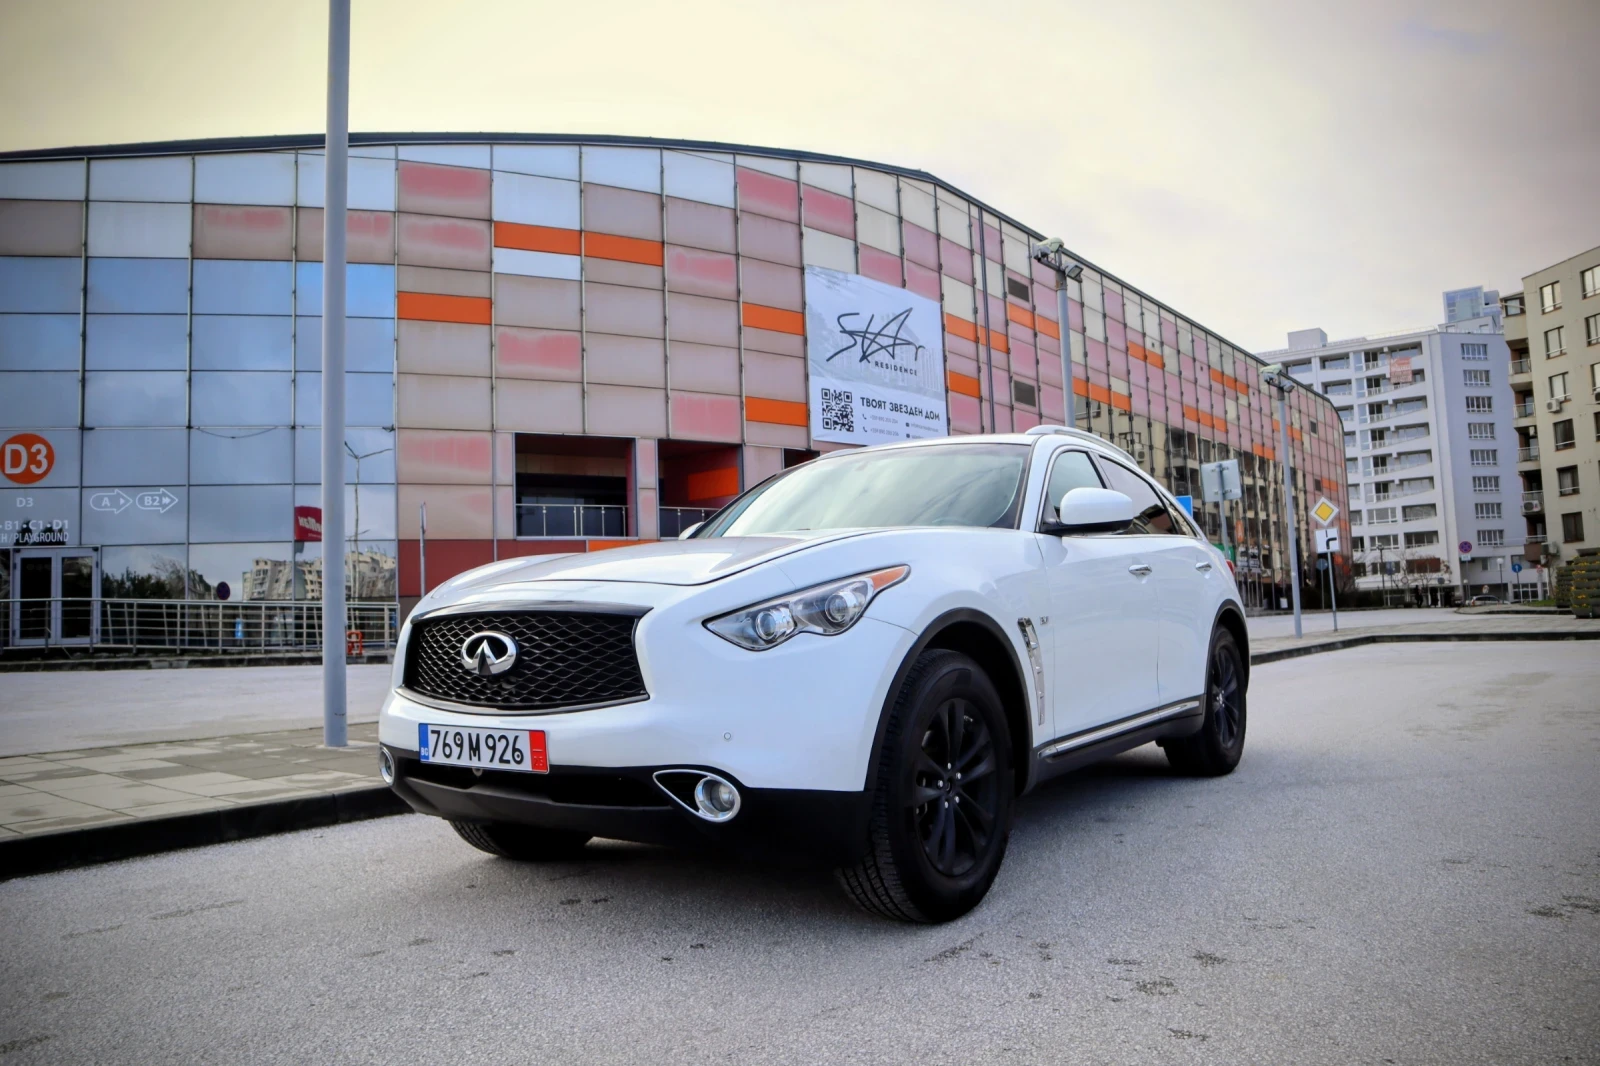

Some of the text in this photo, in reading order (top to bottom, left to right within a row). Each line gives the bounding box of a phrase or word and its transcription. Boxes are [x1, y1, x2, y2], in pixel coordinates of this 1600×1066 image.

[875, 361, 917, 376] RESIDENCE
[860, 397, 940, 421] ТВОЯТ ЗВЕЗДЕН ДОМ
[4, 443, 48, 475] D3
[16, 497, 34, 508] D3
[101, 497, 111, 507] A
[144, 496, 161, 506] B2
[420, 747, 429, 756] BG
